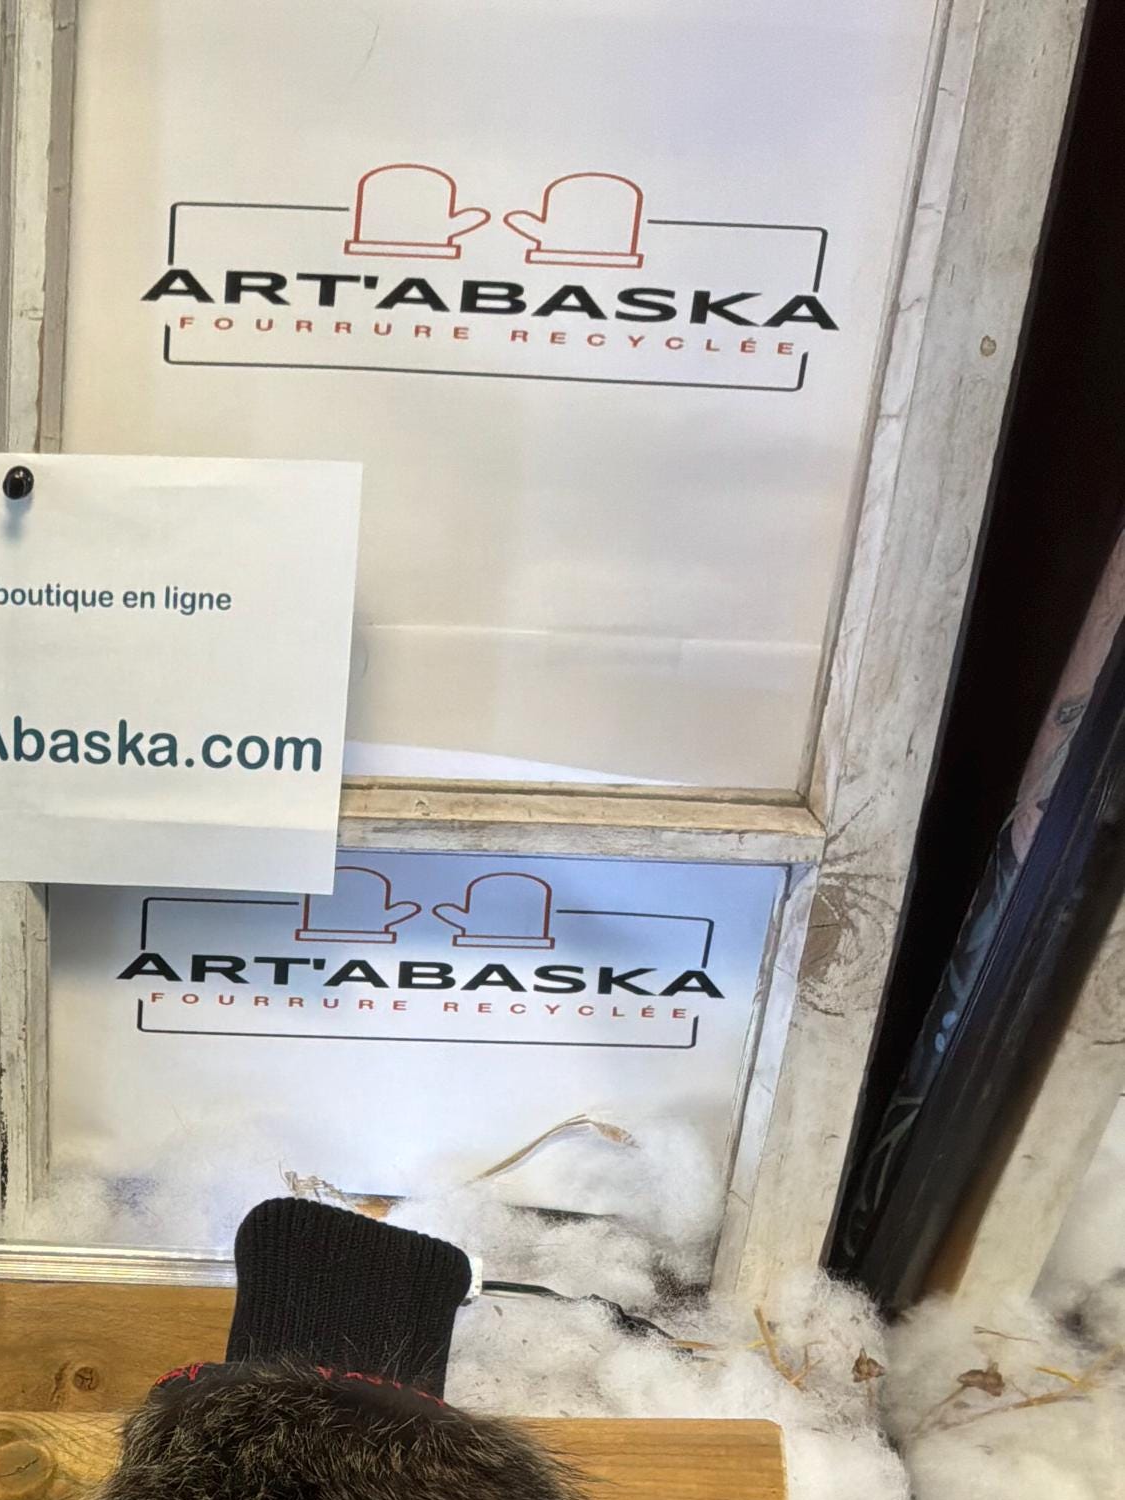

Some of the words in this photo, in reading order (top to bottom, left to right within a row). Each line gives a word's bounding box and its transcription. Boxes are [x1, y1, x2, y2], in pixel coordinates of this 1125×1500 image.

[141, 269, 839, 331] ART'ABASKA
[180, 316, 470, 341] FOURRURE
[511, 328, 795, 356] RECYCLÉE
[122, 588, 156, 610] en
[164, 584, 232, 616] ligne
[116, 952, 726, 999] ART'ABASKA
[150, 992, 408, 1012] FOURRURE
[444, 1001, 687, 1020] RECYCLÉE
